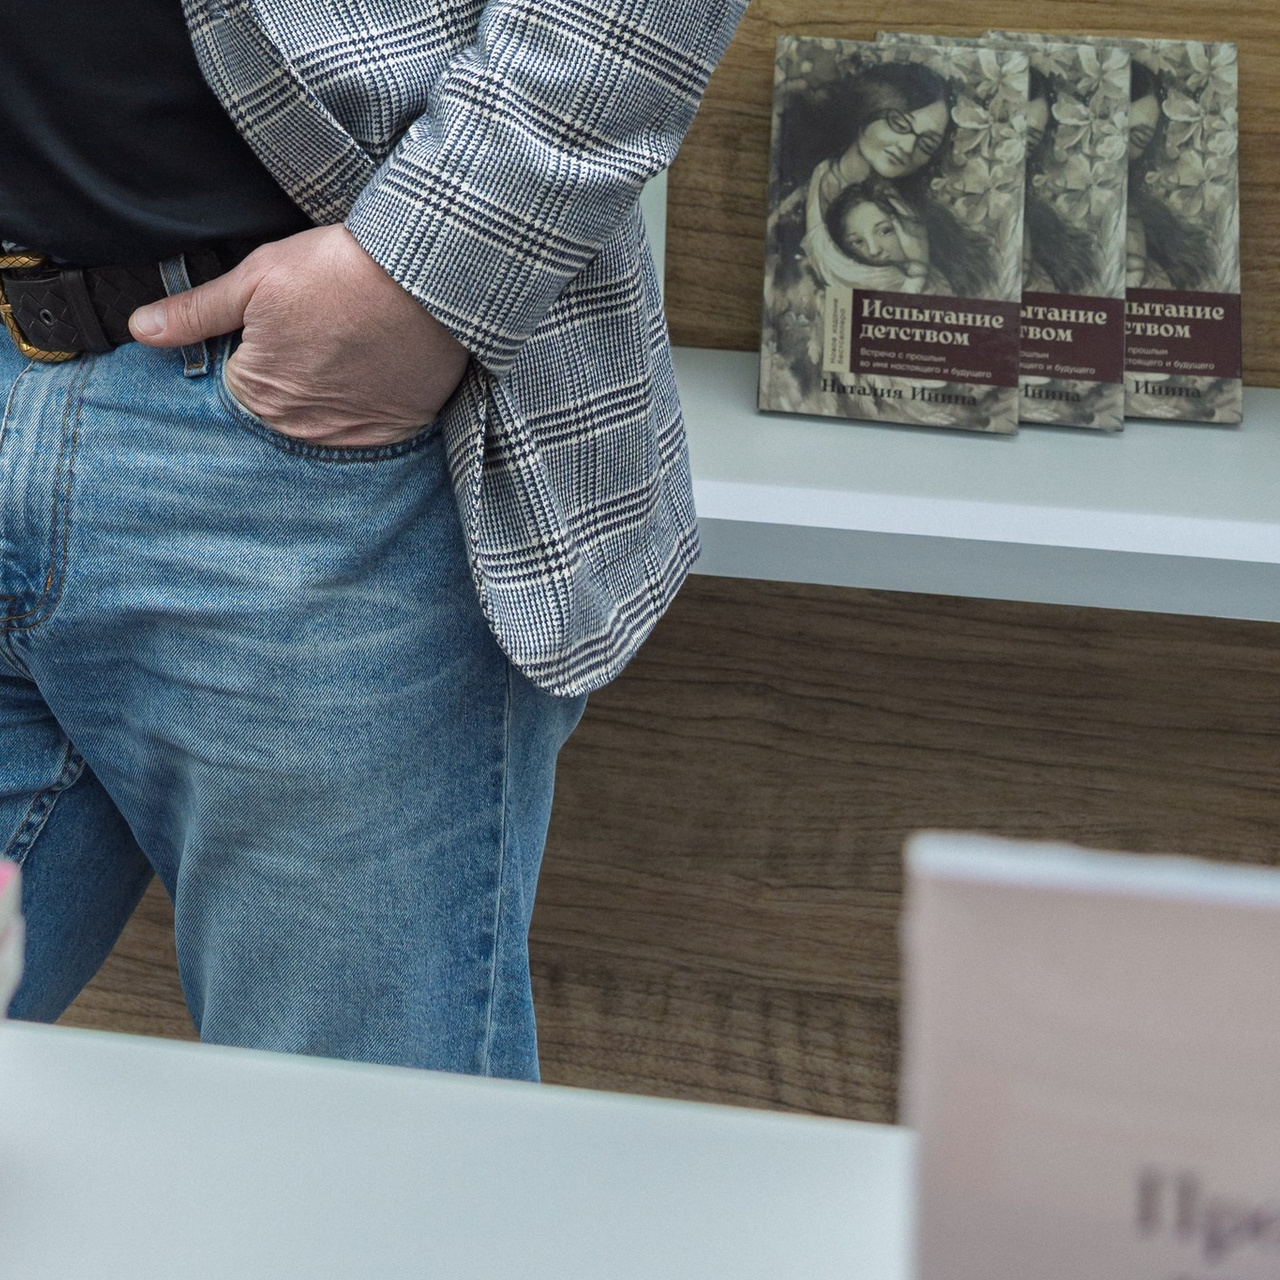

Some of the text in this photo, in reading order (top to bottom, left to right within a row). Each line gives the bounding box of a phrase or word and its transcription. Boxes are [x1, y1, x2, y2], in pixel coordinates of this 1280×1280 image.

[862, 299, 1005, 329] Испытание
[1020, 306, 1107, 325] ытание
[1126, 302, 1225, 321] ытание
[860, 324, 971, 347] детством
[860, 347, 896, 359] Встреча
[906, 353, 946, 363] прошлым
[951, 368, 992, 379] будущего
[822, 378, 978, 407] Наталия Инина
[1134, 380, 1201, 398] Инина
